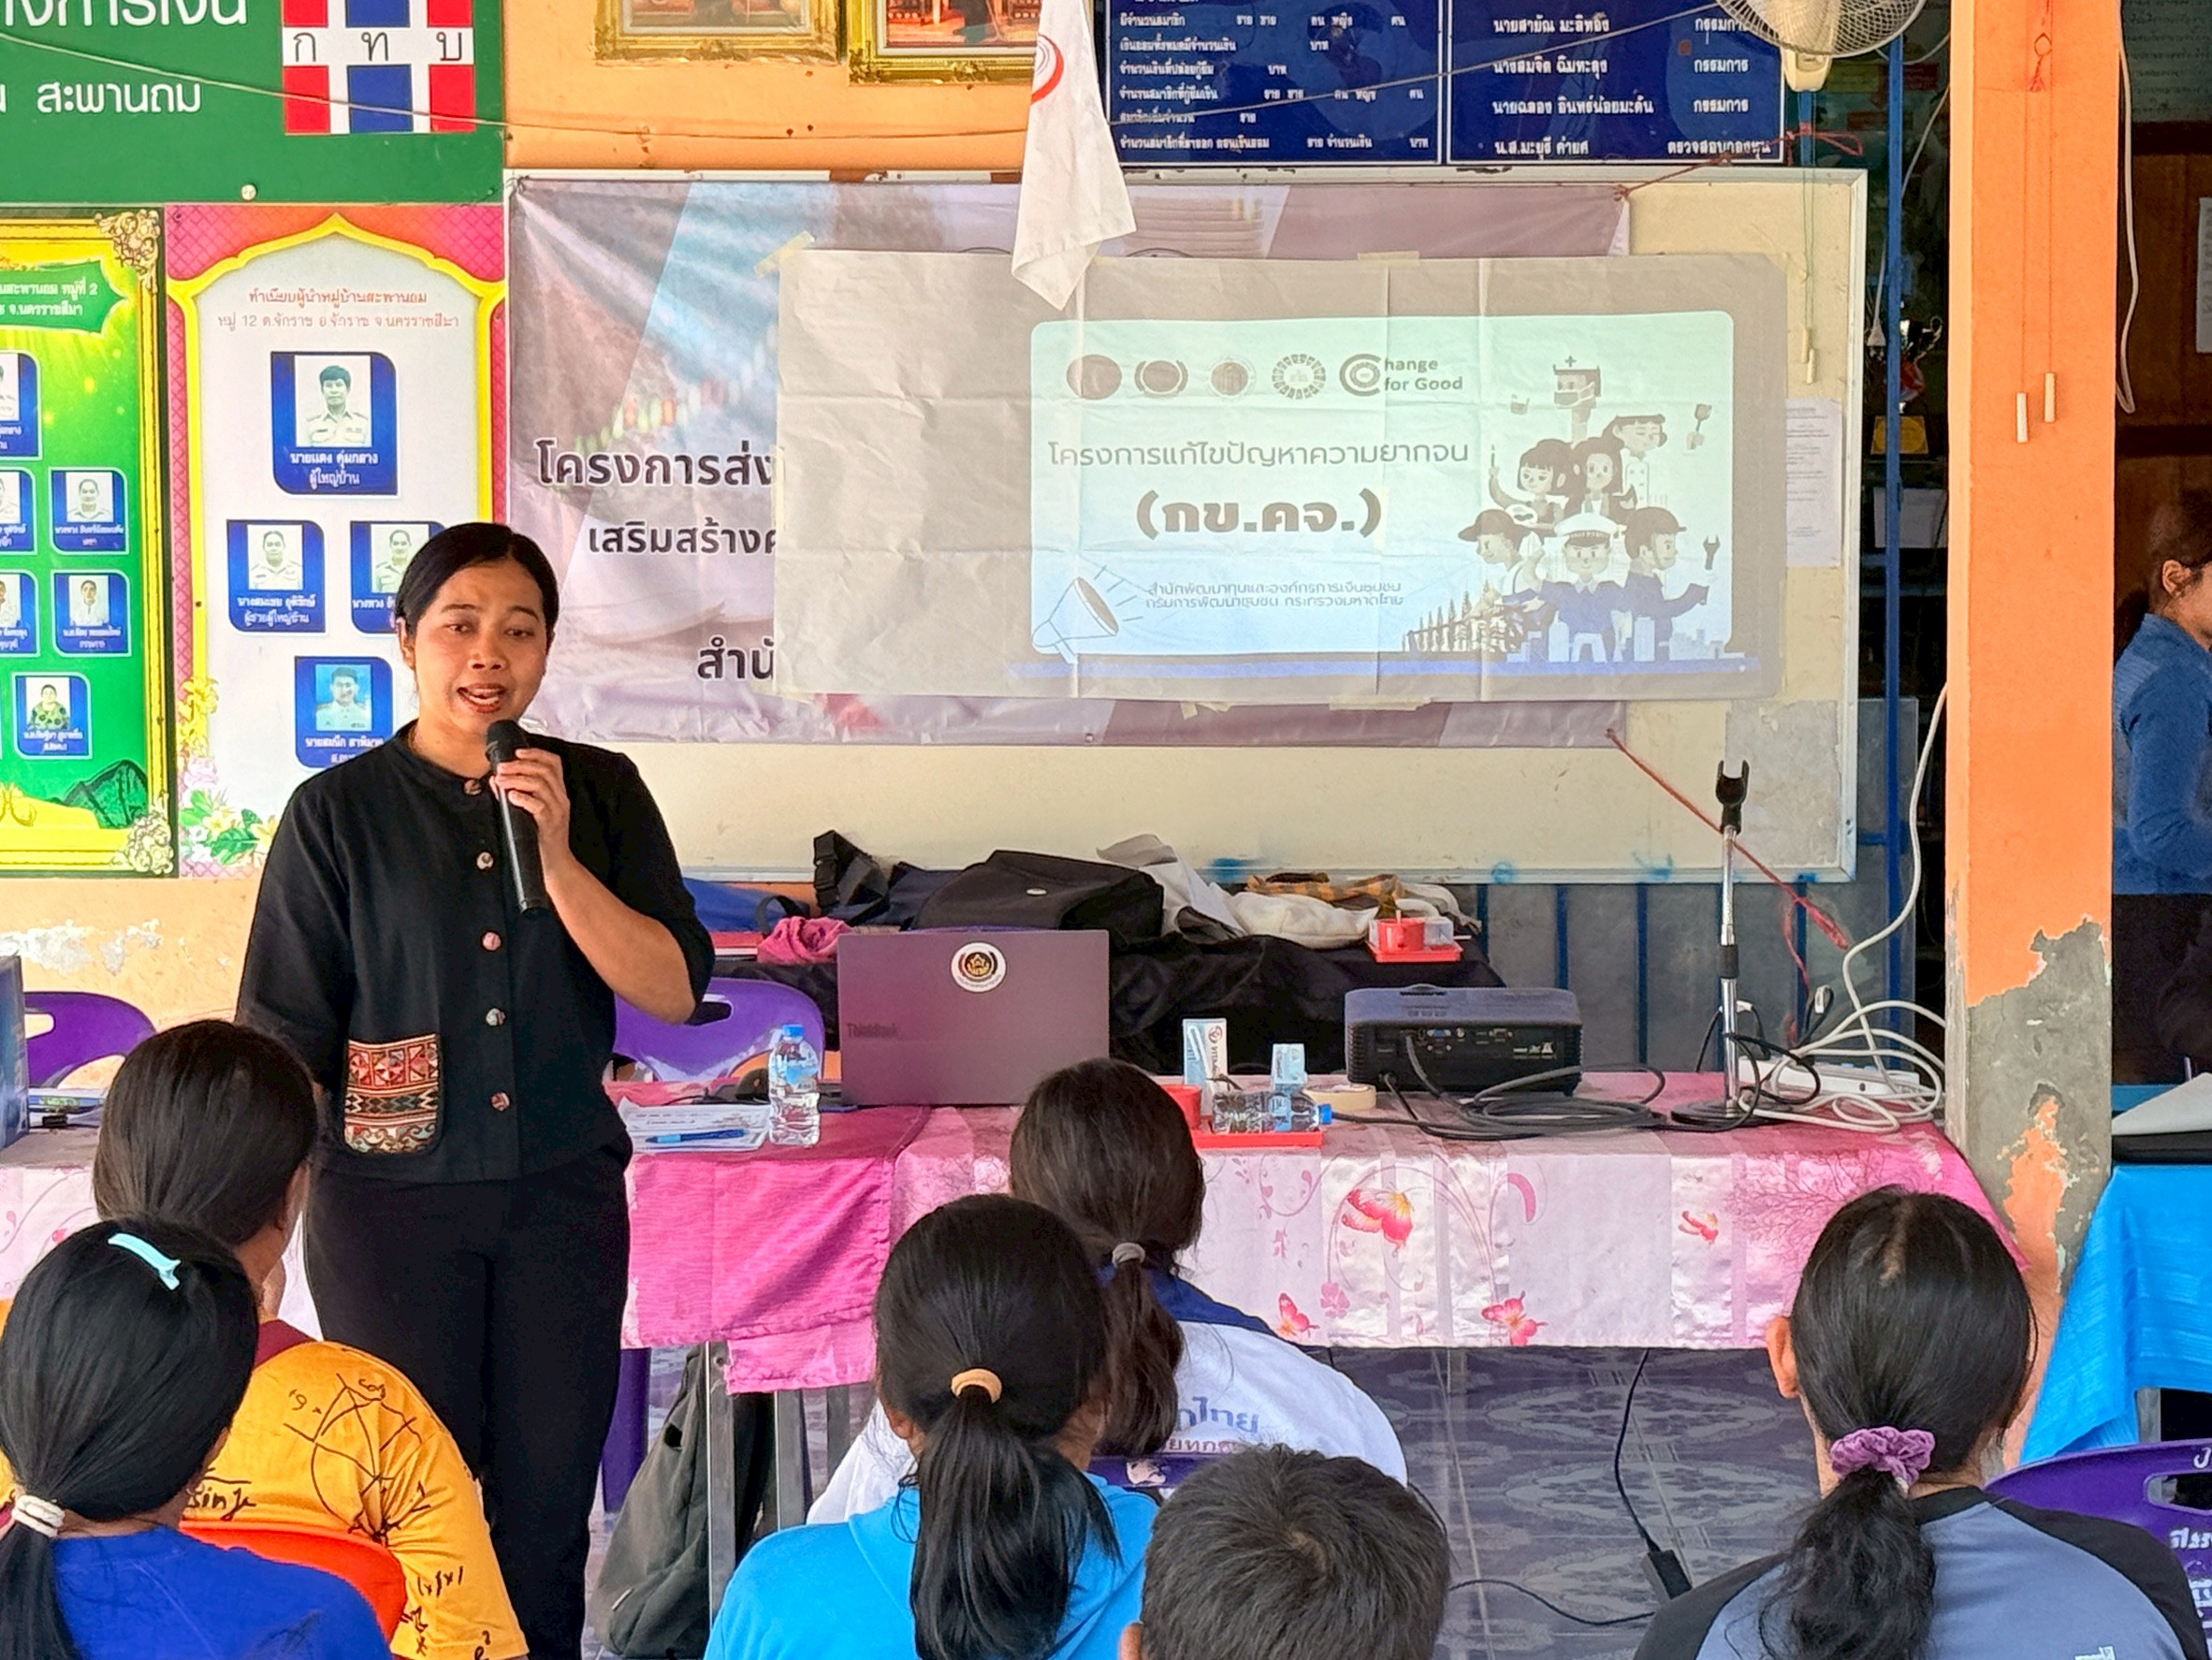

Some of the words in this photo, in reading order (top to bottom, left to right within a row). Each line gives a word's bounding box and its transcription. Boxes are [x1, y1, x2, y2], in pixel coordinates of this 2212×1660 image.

[293, 32, 317, 62] ก
[361, 33, 389, 62] ท
[437, 32, 464, 62] บ
[1695, 59, 1749, 73] กรรมการ
[36, 81, 201, 113] สะพานถม
[1694, 99, 1749, 112] กรรมการ
[89, 284, 98, 295] 2
[242, 315, 257, 327] 12
[1385, 377, 1410, 391] for
[1414, 376, 1463, 391] Good
[1048, 442, 1468, 467] โครงการแก้ไขปัญหาความยากจน
[1137, 488, 1382, 540] (กข.คจ.)
